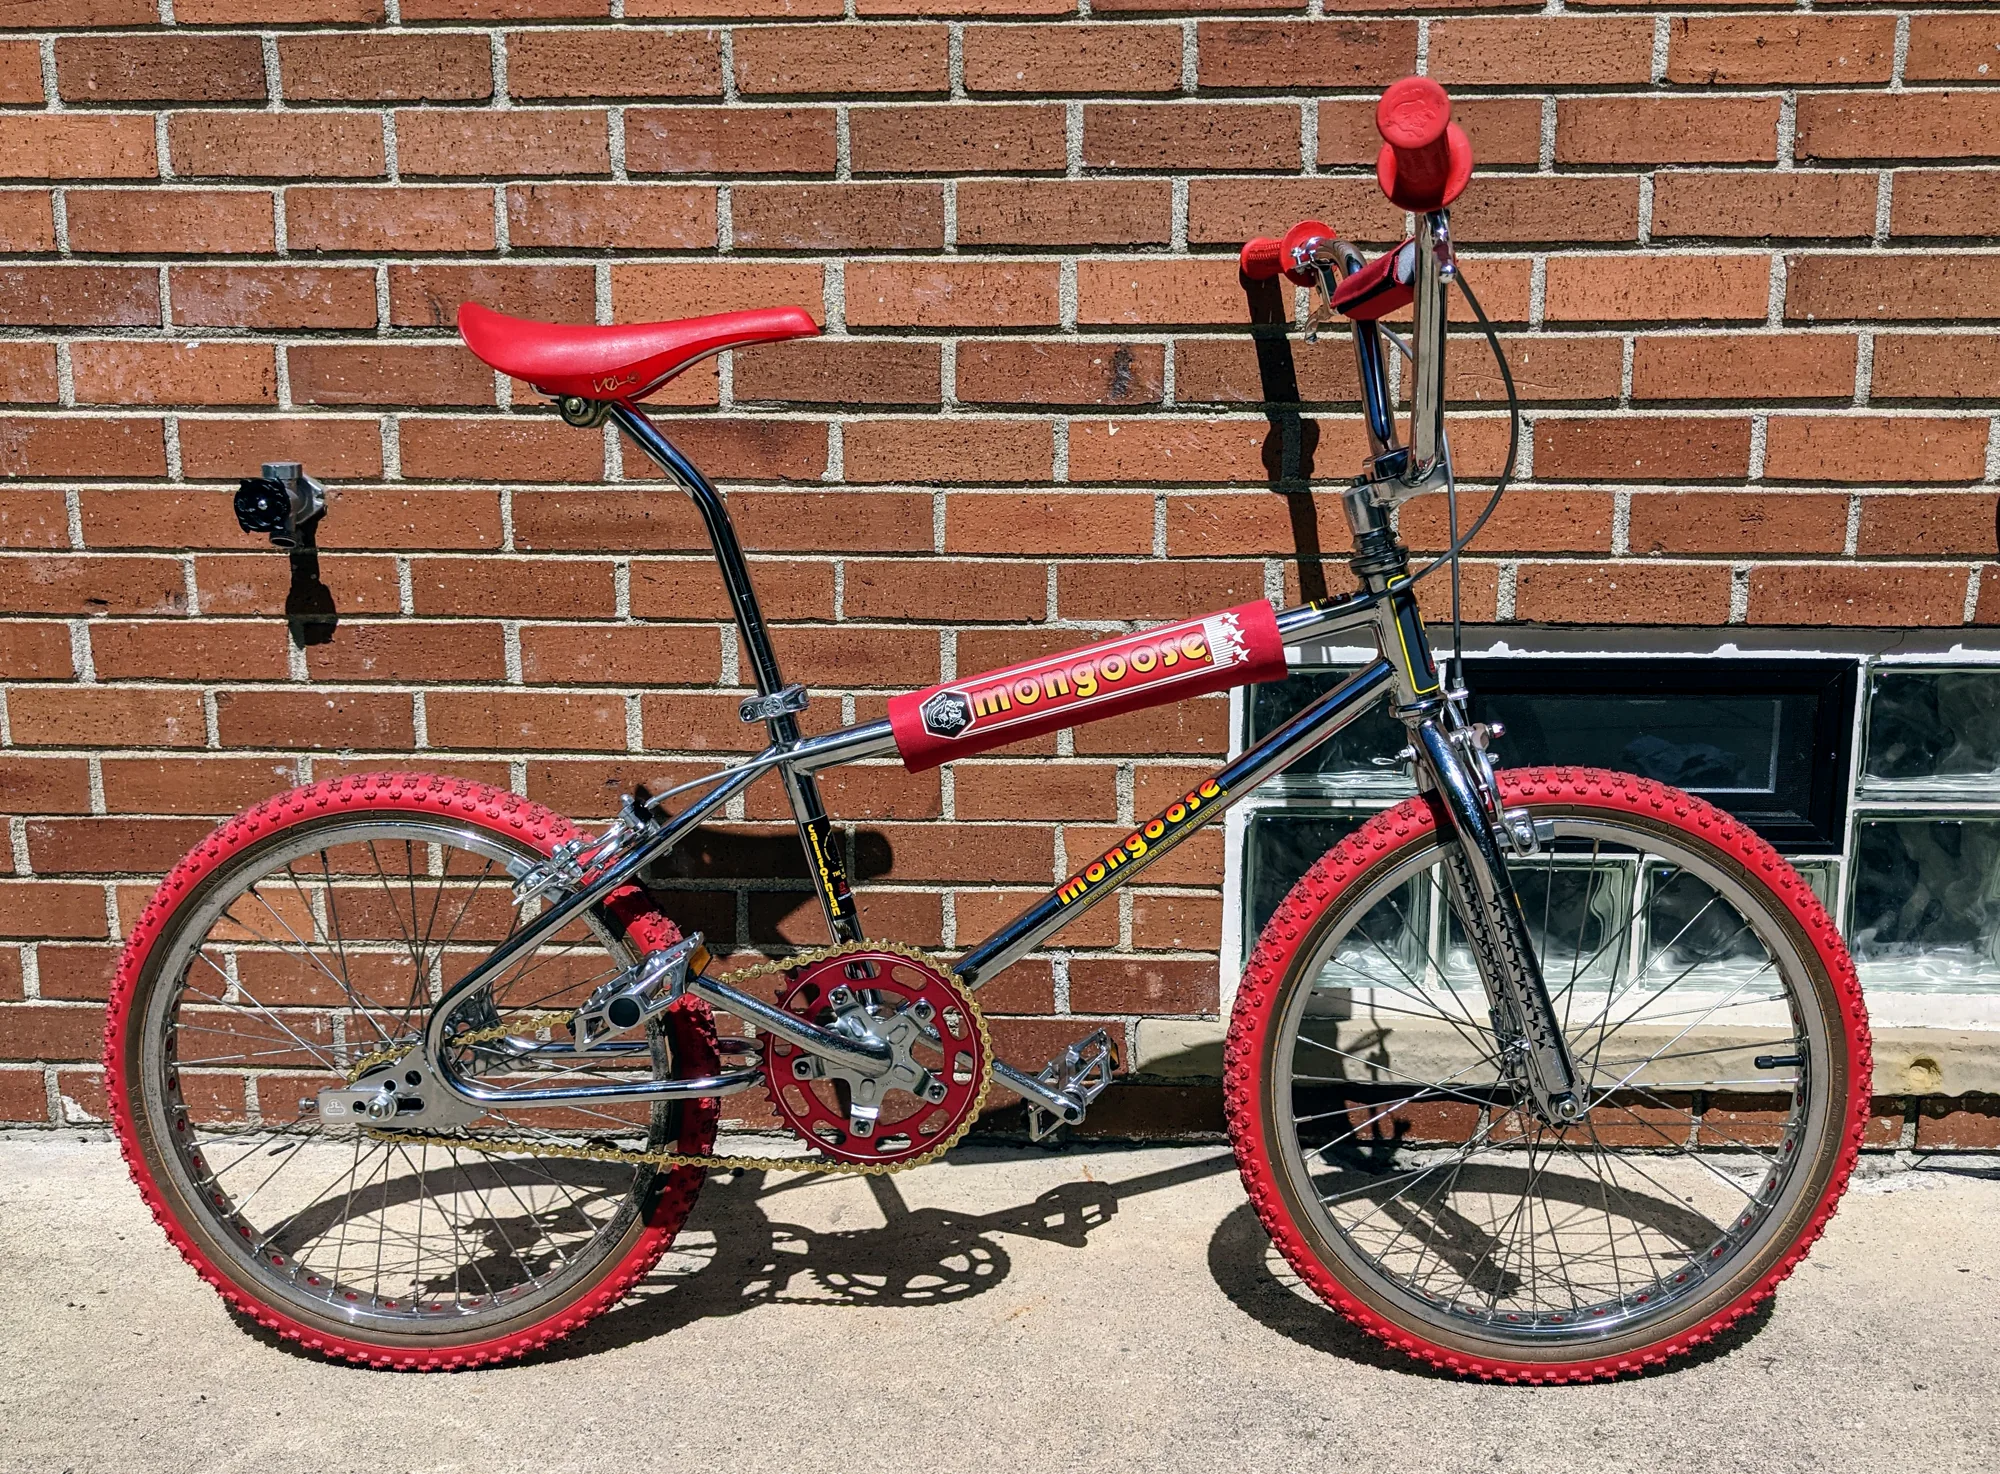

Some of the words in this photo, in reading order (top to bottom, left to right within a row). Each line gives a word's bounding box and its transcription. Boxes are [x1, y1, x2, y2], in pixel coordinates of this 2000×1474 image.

[973, 632, 1209, 717] mongoose
[807, 824, 841, 917] californian
[1056, 778, 1221, 905] mongoose
